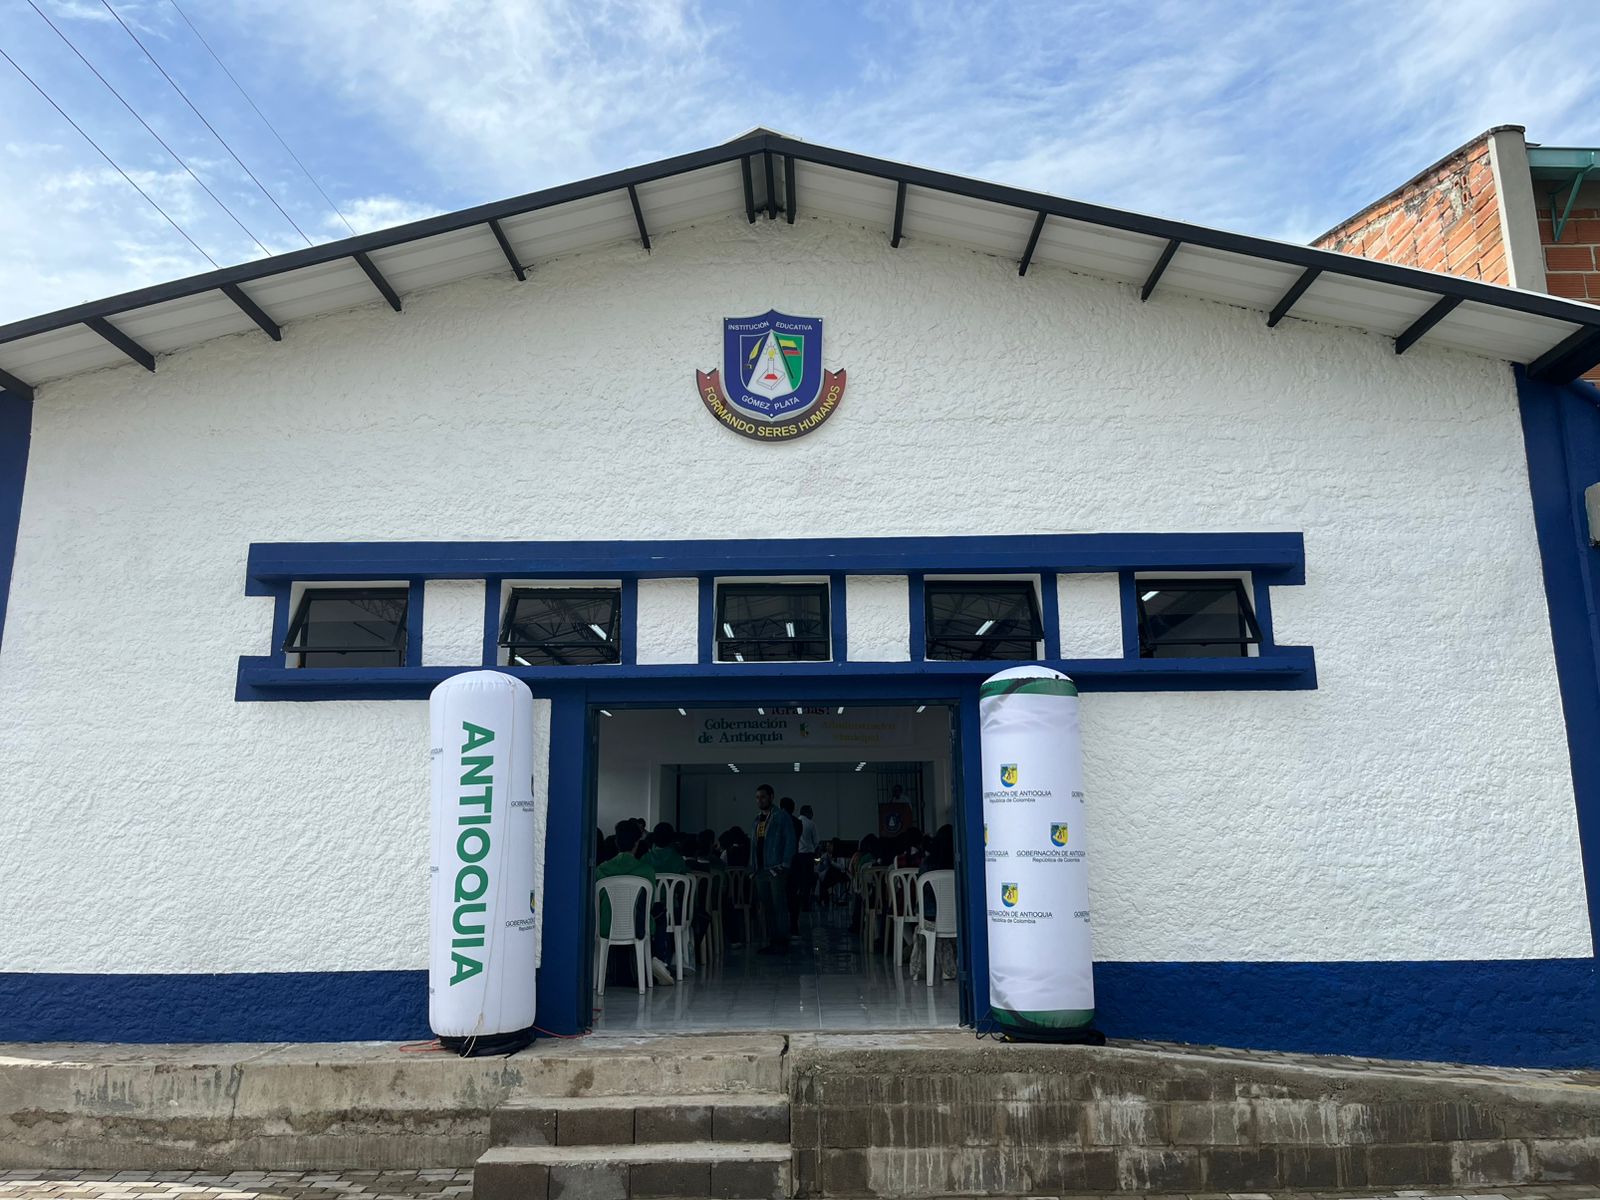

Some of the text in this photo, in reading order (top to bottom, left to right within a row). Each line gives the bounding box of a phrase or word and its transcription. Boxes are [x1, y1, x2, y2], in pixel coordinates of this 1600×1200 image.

[775, 321, 813, 331] EDUCATIVA
[774, 396, 800, 410] PLATA
[704, 385, 840, 437] FORMANDO SERES HUMANOS
[704, 717, 787, 730] Gobernación
[698, 731, 783, 745] de Antioquia
[450, 720, 495, 987] ANTIOQUIA
[1016, 849, 1060, 857] GOBERNACIÓN
